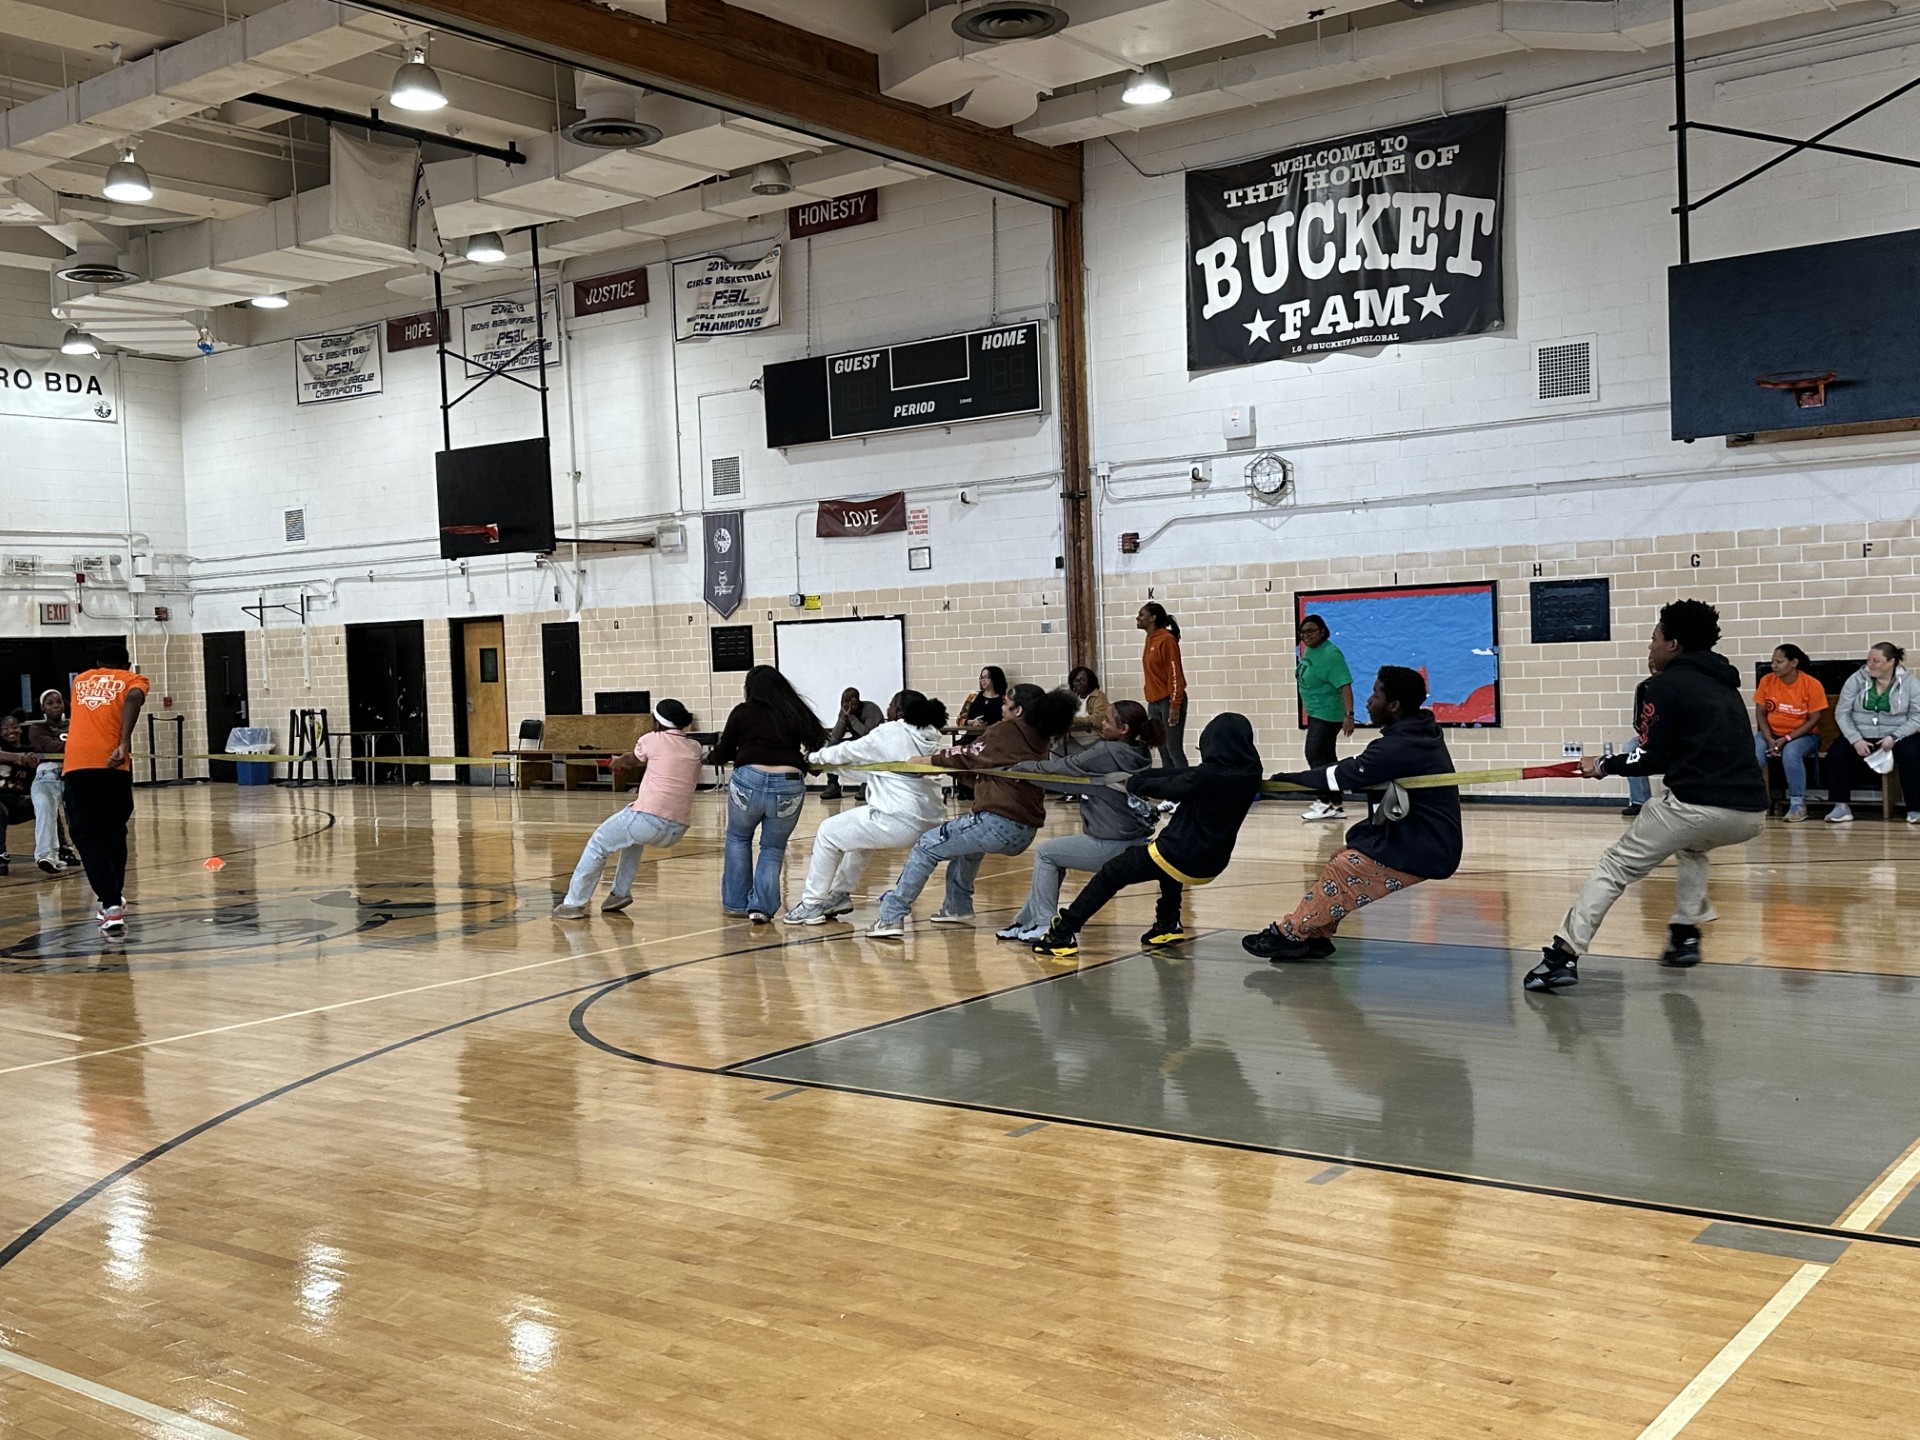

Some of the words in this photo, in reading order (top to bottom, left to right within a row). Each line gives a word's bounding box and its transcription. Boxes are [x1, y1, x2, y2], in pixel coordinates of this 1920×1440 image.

[1271, 141, 1376, 177] WELCOME
[1381, 135, 1408, 154] TO
[1223, 178, 1288, 208] THE
[1304, 155, 1406, 191] HOME
[1414, 144, 1460, 170] OF
[799, 194, 867, 227] HONESTY
[1195, 191, 1496, 320] BUCKET
[686, 277, 713, 289] GIRLS
[715, 270, 773, 285] BASKETBALL
[585, 280, 635, 305] JUSTICE
[1278, 285, 1411, 342] FAM
[405, 322, 433, 341] HOPE
[693, 317, 763, 332] CHAMPIONS
[496, 328, 528, 345] PSAL
[981, 329, 1028, 351] HOME
[1306, 333, 1400, 351] @BUCKETFAMGLOBAL
[325, 360, 355, 376] PSAL
[834, 353, 881, 375] GUEST
[44, 371, 102, 396] BDA
[893, 400, 936, 418] PERIOD
[842, 508, 879, 528] LOVE
[1863, 543, 1873, 558] F
[1690, 553, 1701, 568] G
[1533, 563, 1542, 577] H
[1148, 587, 1154, 599] K
[1265, 581, 1272, 592] J
[1043, 594, 1049, 605] L
[46, 604, 68, 620] EXIT
[852, 605, 858, 616] N
[688, 616, 693, 625] P
[76, 680, 124, 692] WORLD
[79, 688, 115, 699] SERIES
